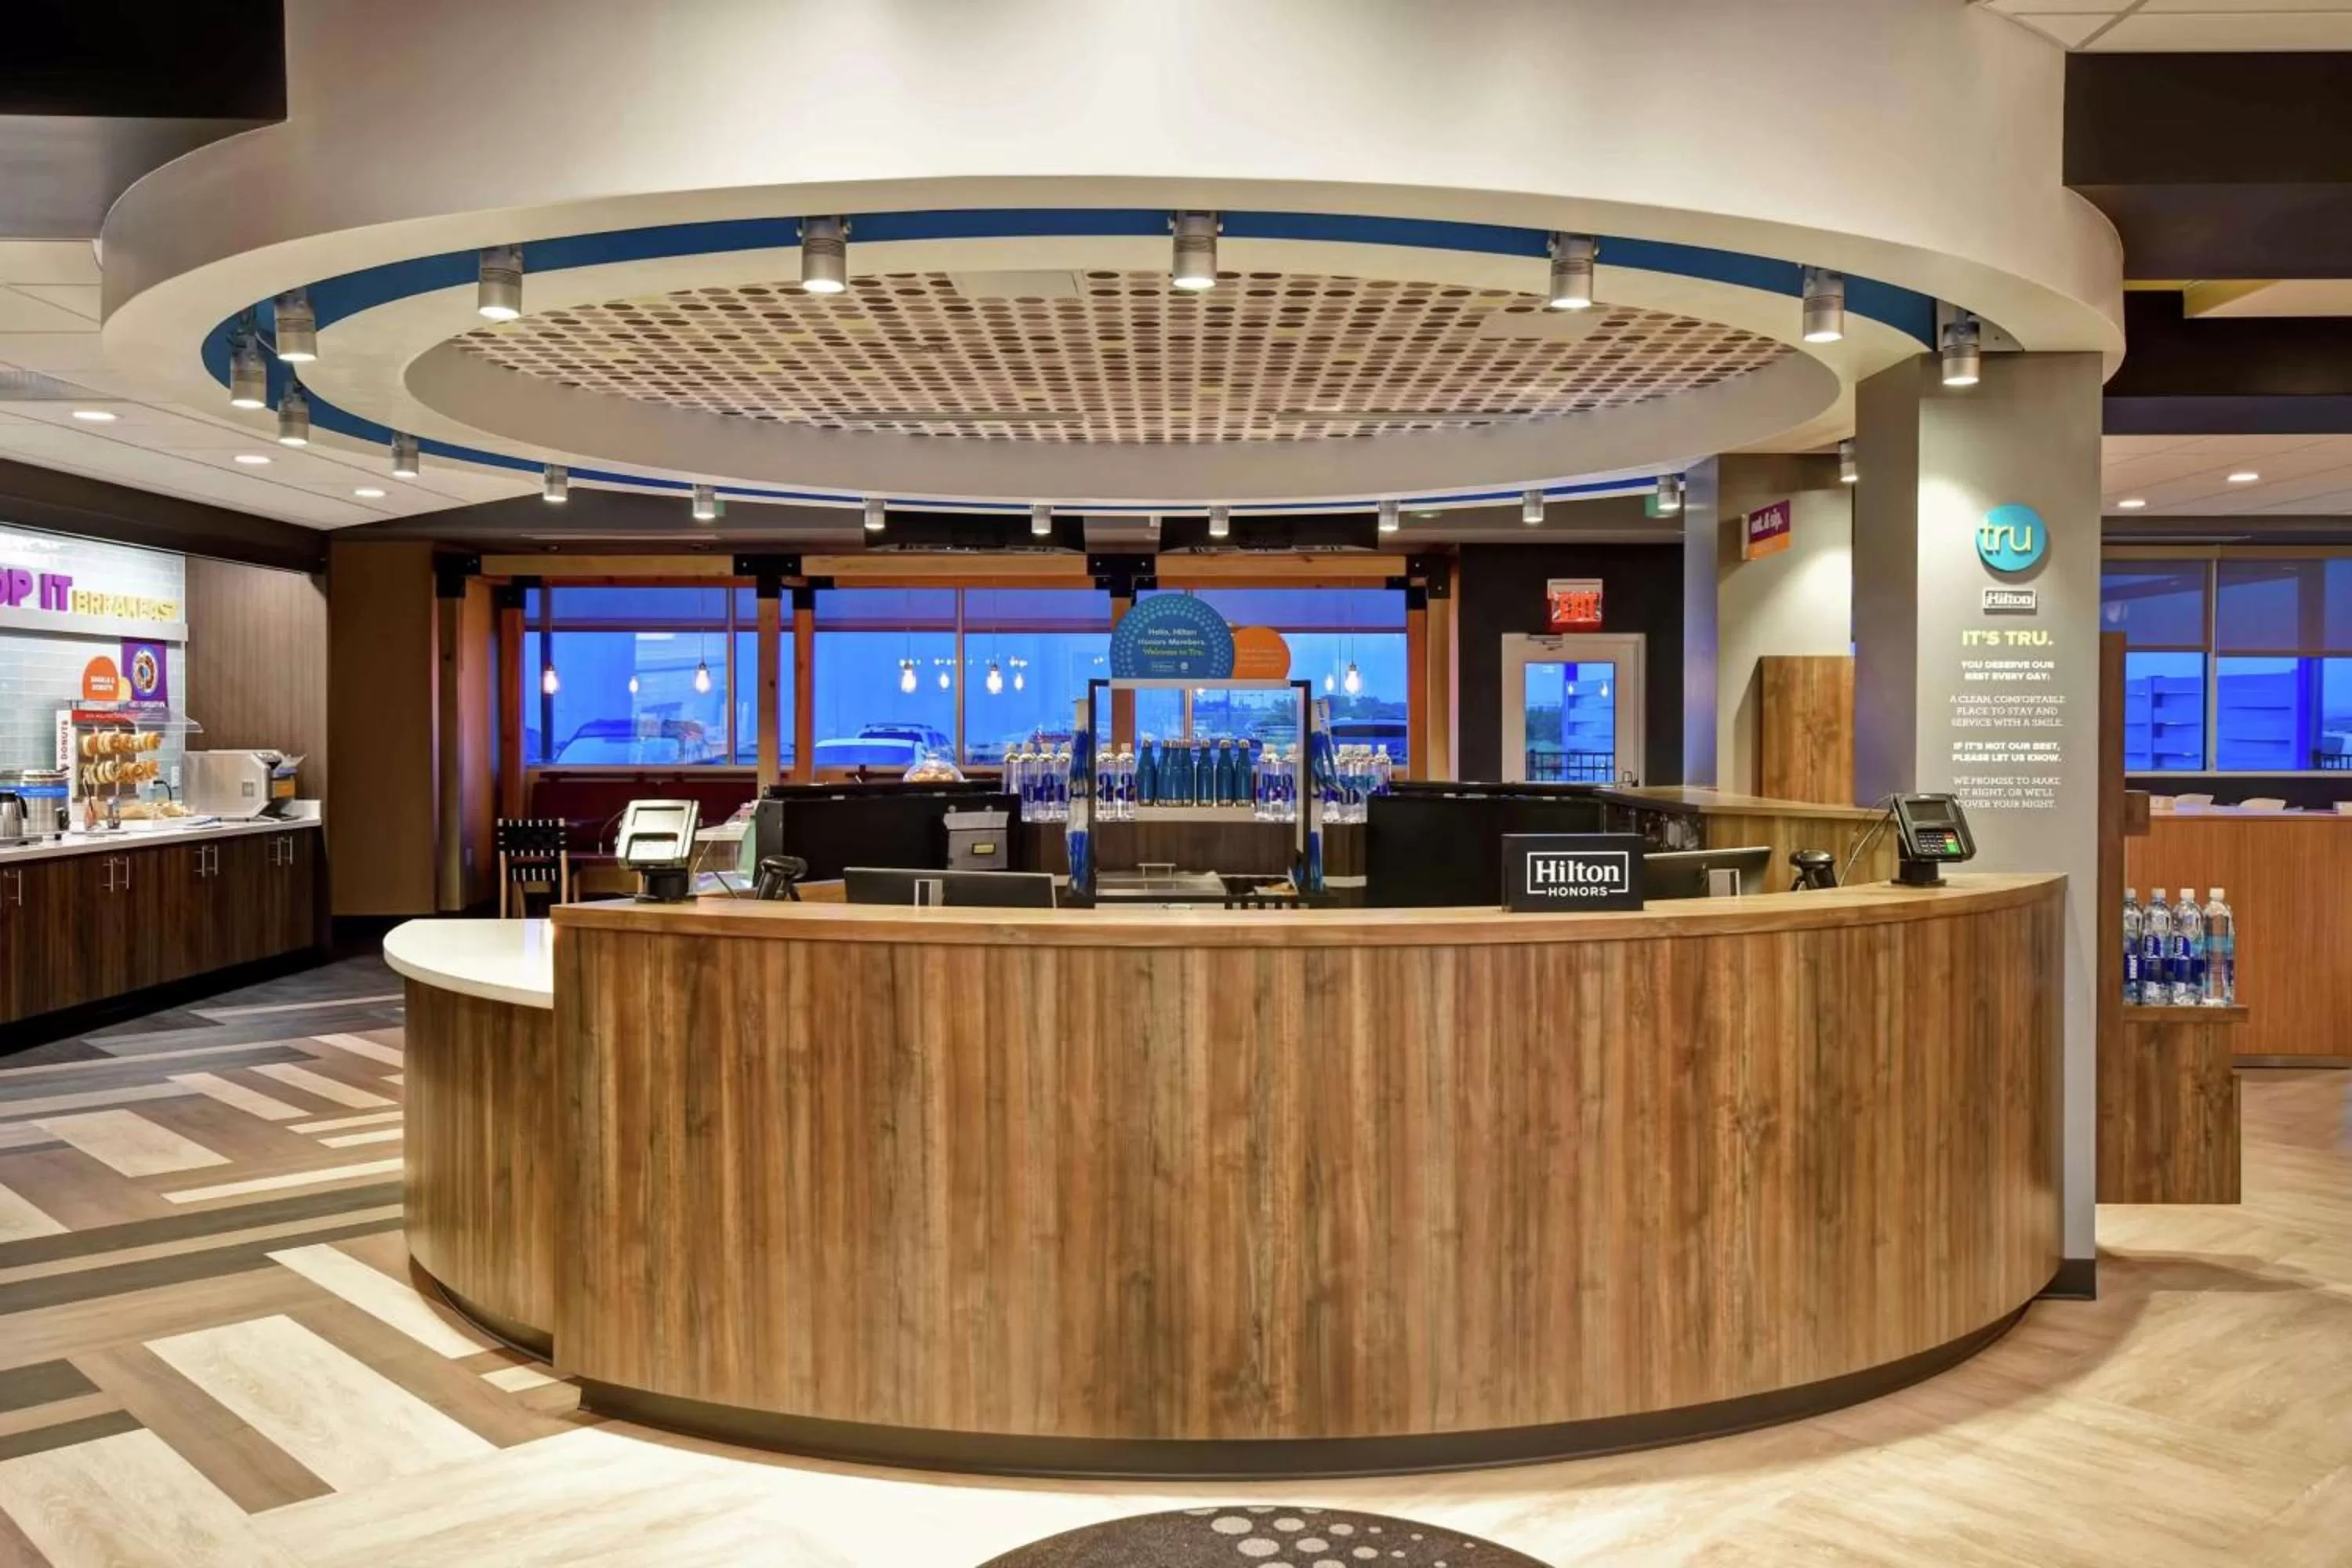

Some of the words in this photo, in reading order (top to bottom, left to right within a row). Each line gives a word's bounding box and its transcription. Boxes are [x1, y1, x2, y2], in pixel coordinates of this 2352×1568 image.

[1980, 521, 2032, 551] tru
[40, 573, 73, 611] IT
[1987, 592, 2031, 604] Hilton
[1962, 630, 2000, 646] IT'S
[2004, 630, 2054, 646] TRU.
[1962, 660, 1983, 669] YOU
[1984, 660, 2030, 669] DESERVE
[2032, 660, 2054, 669] OUR
[1965, 672, 1990, 681] BEST
[1991, 672, 2025, 681] EVERY
[1950, 695, 1957, 704] A
[1956, 706, 1988, 716] PLACE
[1991, 706, 2005, 716] TO
[2006, 706, 2034, 716] STAY
[2035, 706, 2058, 716] AND
[1951, 717, 1992, 727] SERVICE
[1994, 717, 2020, 727] WITH
[2023, 717, 2030, 727] A
[1953, 742, 1963, 750] IF
[1984, 742, 2006, 750] NOT
[2008, 742, 2031, 750] OUR
[1959, 788, 1969, 797] IT
[2008, 788, 2022, 797] OR
[1992, 799, 2020, 808] YOUR
[1535, 860, 1621, 883] Hilton
[1548, 887, 1608, 897] HONORS
